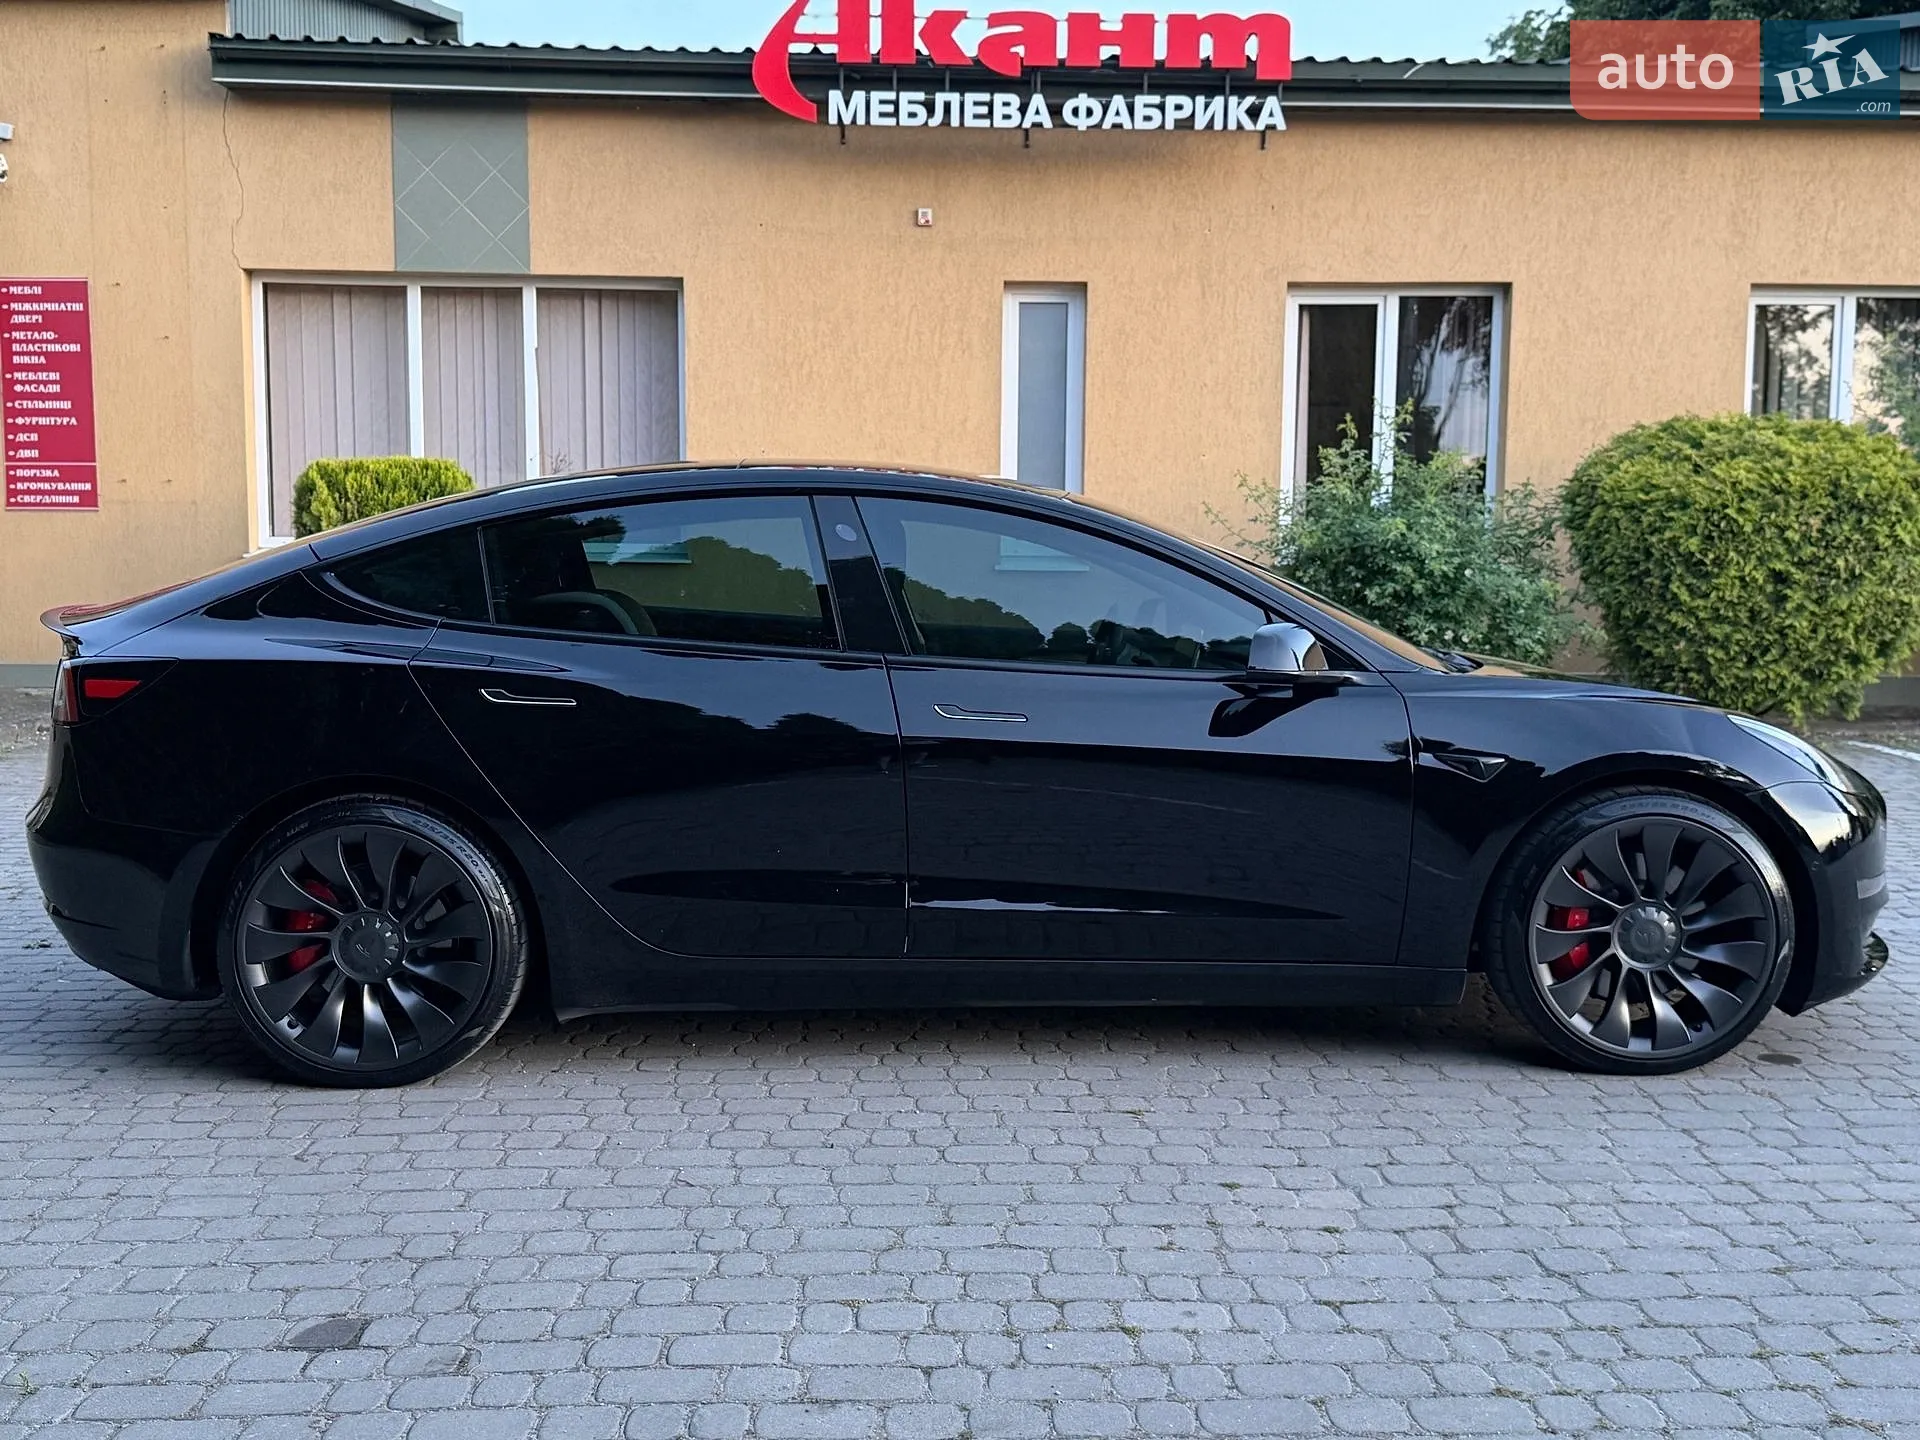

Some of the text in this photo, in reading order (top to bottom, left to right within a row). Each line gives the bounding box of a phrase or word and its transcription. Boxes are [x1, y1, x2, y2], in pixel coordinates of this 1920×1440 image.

[752, 0, 1293, 123] Акант
[827, 89, 1287, 131] МЕБЛЕВА ФАБРИКА
[9, 286, 42, 295] МЕБЛІ
[10, 302, 84, 311] МІЖКІМНАТНІ
[10, 314, 42, 323] ДВЕРІ
[11, 331, 58, 340] МЕТАЛО-
[12, 343, 81, 352] ПЛАСТИКОВІ
[13, 355, 46, 364] ВІКНА
[13, 371, 60, 381] МЕБЛЕВІ
[13, 384, 61, 393] ФАСАДИ
[14, 400, 72, 409] СТІЛЬНИЦІ
[15, 416, 78, 425] ФУРНІТУРА
[16, 432, 39, 442] ДСП
[16, 449, 39, 458] ДВП
[16, 469, 60, 477] ПОРІЗКА
[16, 482, 92, 491] КРОМКУВАННЯ
[16, 495, 80, 503] СВЕРДЛІННЯ
